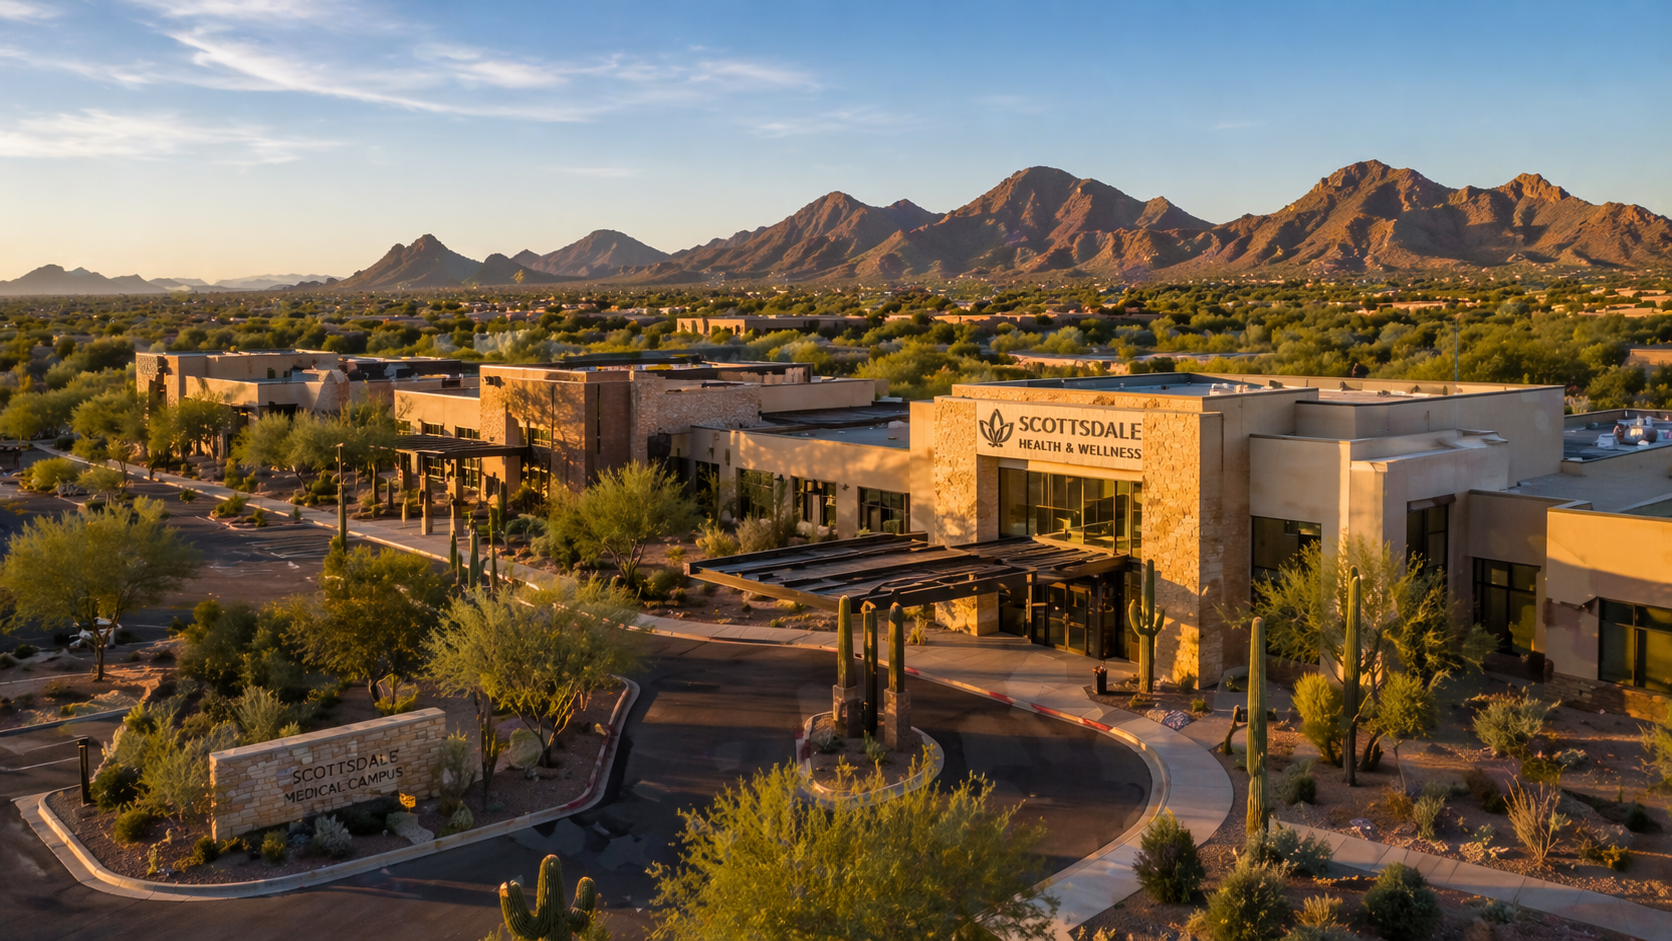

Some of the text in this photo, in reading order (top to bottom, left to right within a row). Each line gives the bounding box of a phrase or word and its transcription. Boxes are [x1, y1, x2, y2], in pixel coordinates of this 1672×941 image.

[1018, 416, 1142, 440] SCOTTSDALE
[1019, 439, 1142, 459] HEALTH & WELLNESS
[293, 749, 399, 784] SCOTTSDALE
[285, 767, 403, 803] MEDICAL CAMPUS
